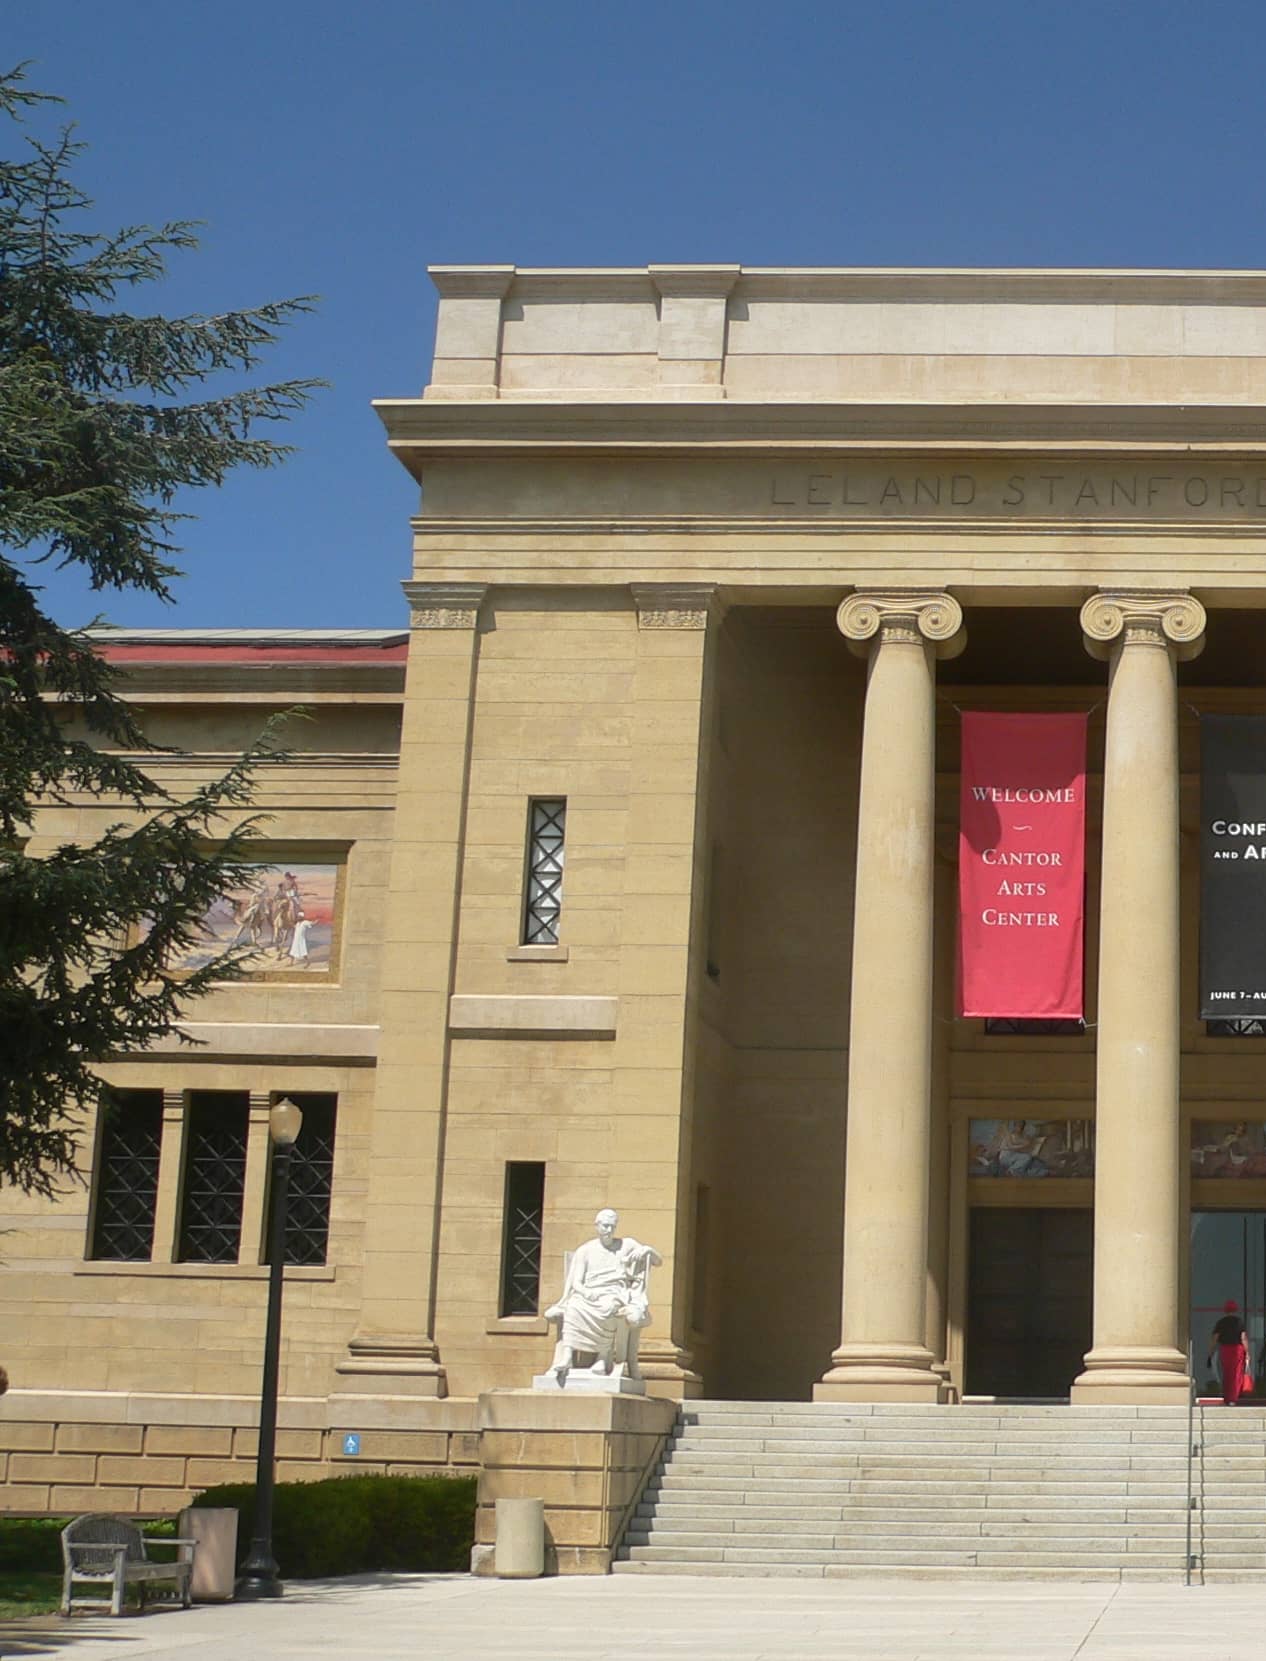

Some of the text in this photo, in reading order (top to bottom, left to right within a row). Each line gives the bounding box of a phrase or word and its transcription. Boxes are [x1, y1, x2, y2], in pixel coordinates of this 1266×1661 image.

[771, 474, 976, 505] LELAND
[972, 787, 1075, 803] WELCOME
[982, 849, 1062, 866] CANTOR
[1214, 851, 1239, 859] AND
[997, 880, 1046, 896] ARTS
[982, 909, 1060, 926] CENTER
[1210, 991, 1236, 1000] JUNE
